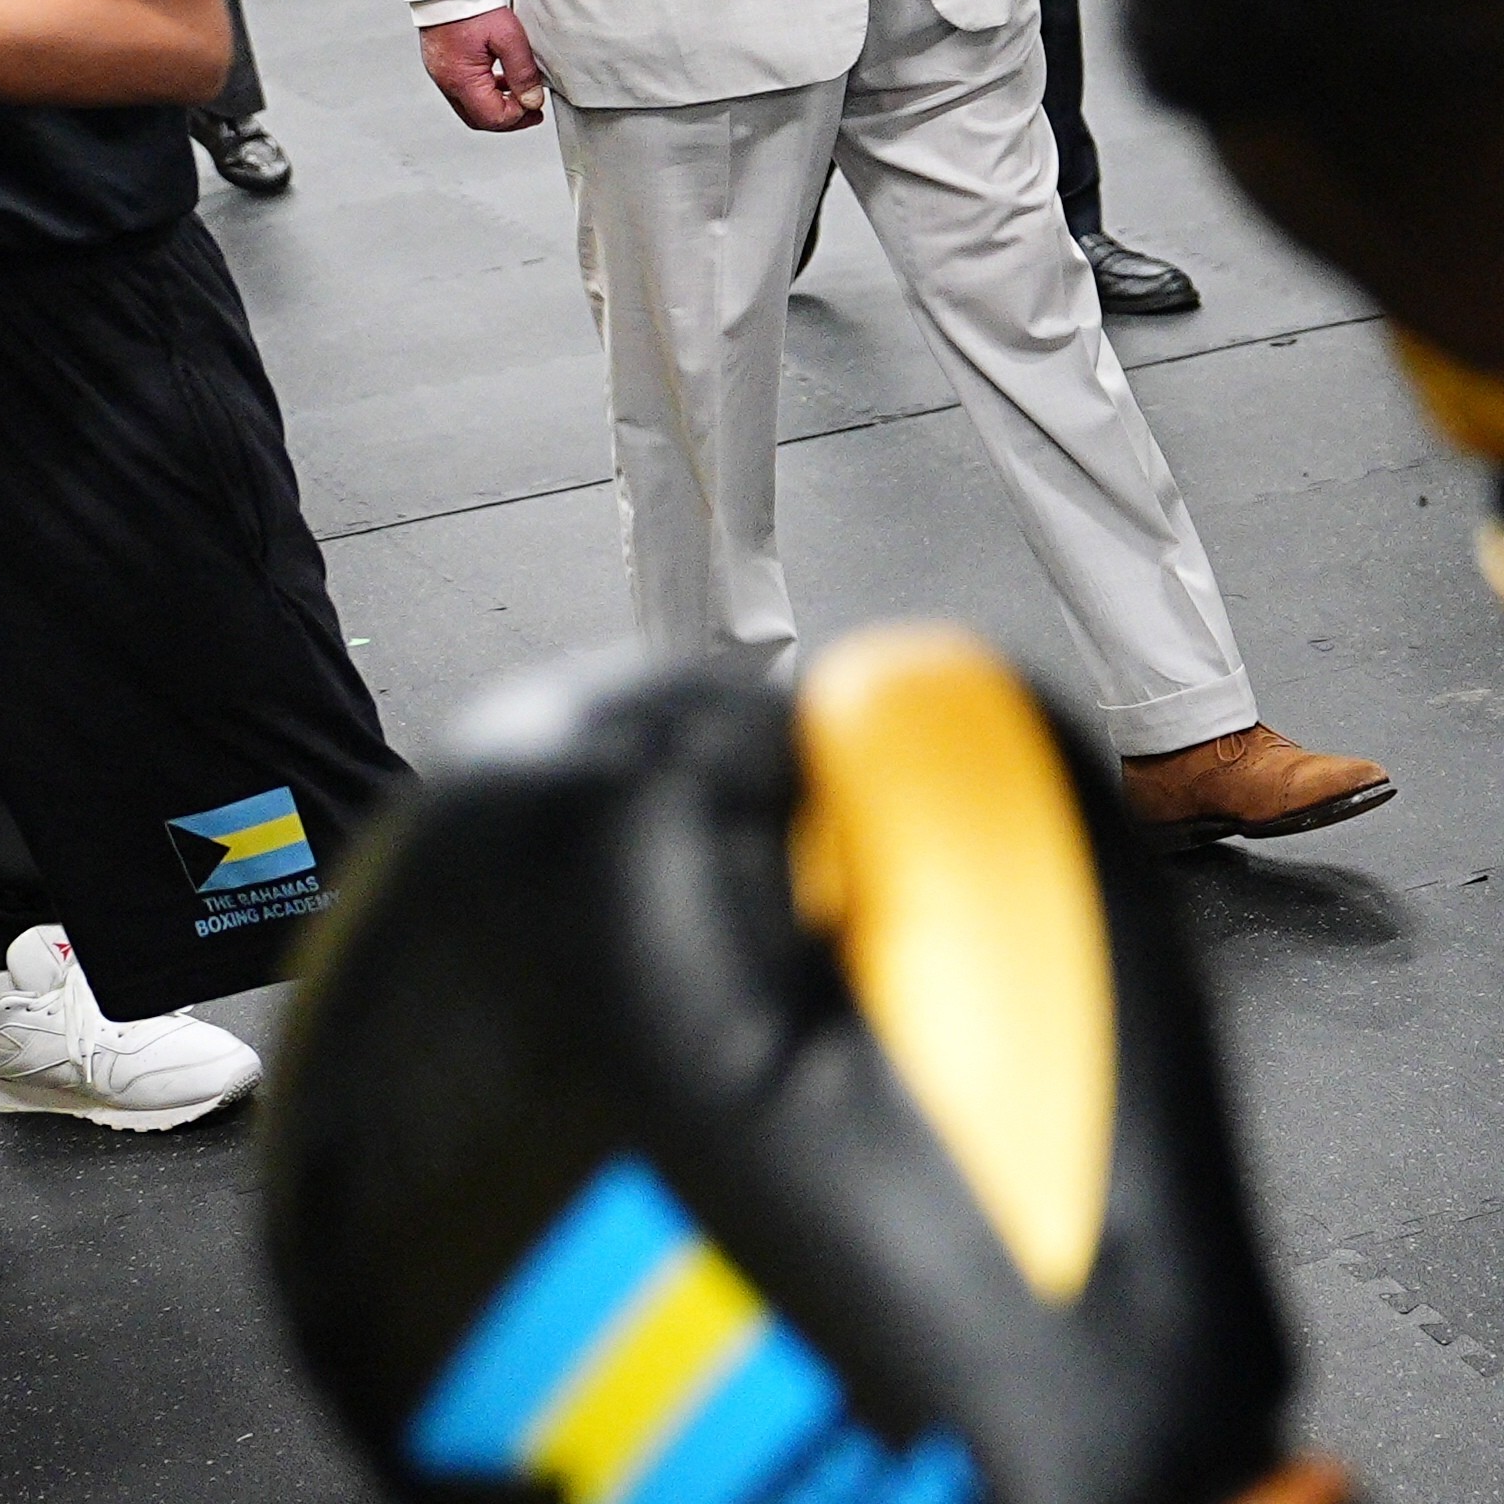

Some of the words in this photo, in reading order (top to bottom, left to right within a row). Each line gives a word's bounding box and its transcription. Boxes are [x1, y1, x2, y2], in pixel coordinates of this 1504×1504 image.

[203, 894, 237, 912] THE
[237, 875, 320, 905] BAHAMAS
[195, 907, 260, 938] BOXING
